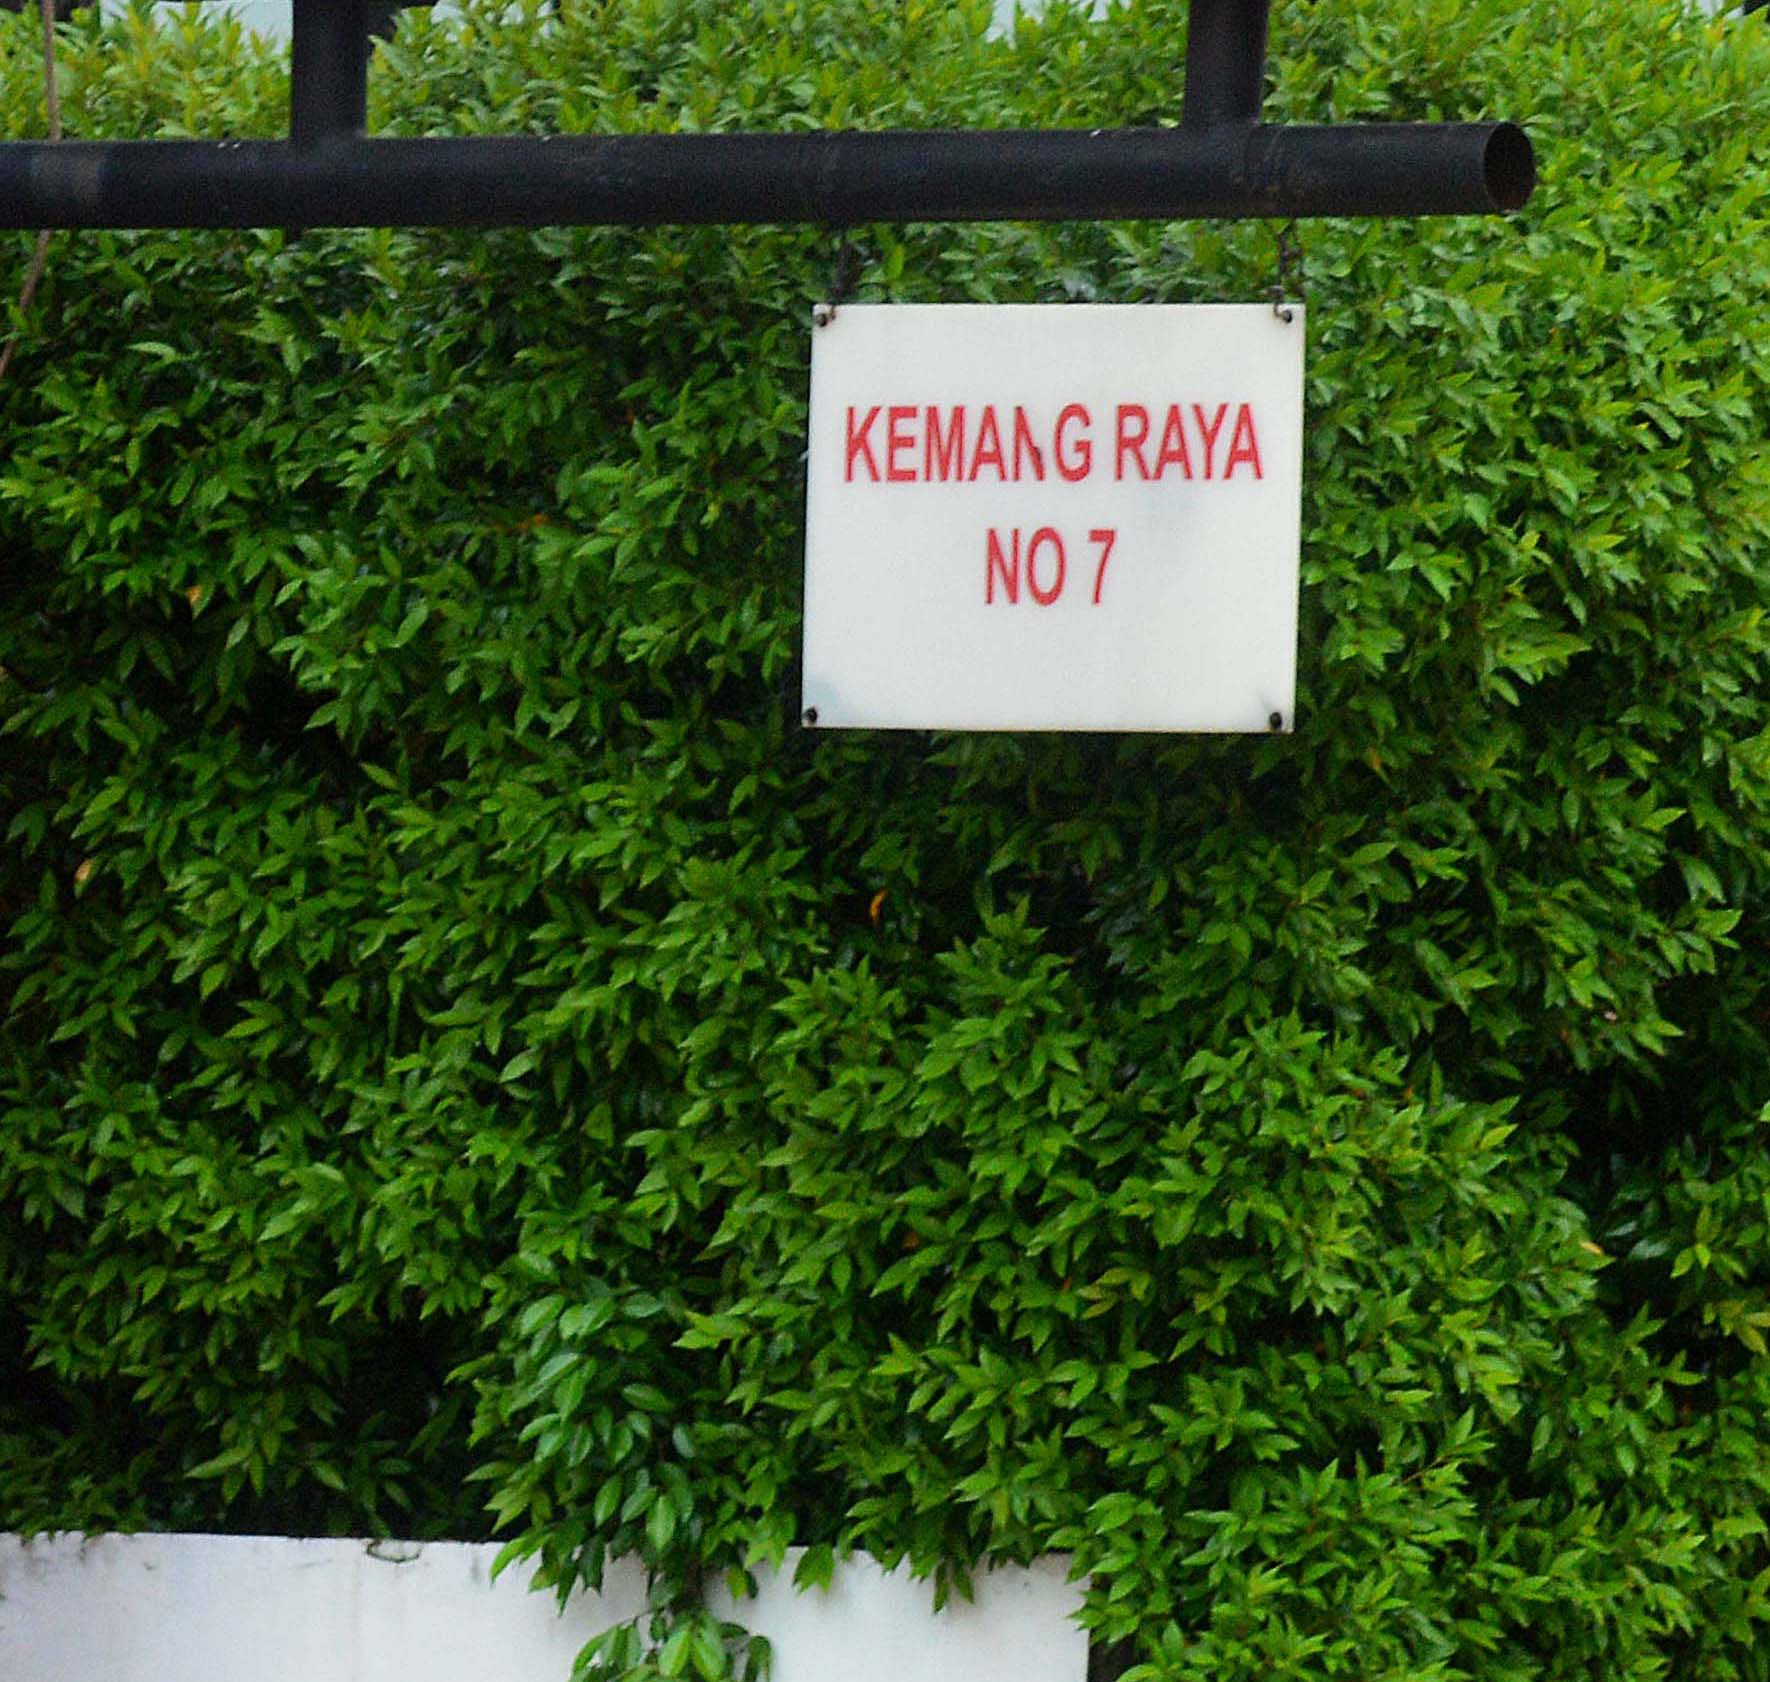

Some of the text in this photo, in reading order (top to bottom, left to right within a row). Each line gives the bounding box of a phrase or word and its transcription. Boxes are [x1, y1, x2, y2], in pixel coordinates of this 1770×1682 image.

[844, 402, 1264, 484] KEMANG RAYA
[985, 526, 1118, 607] NO 7
